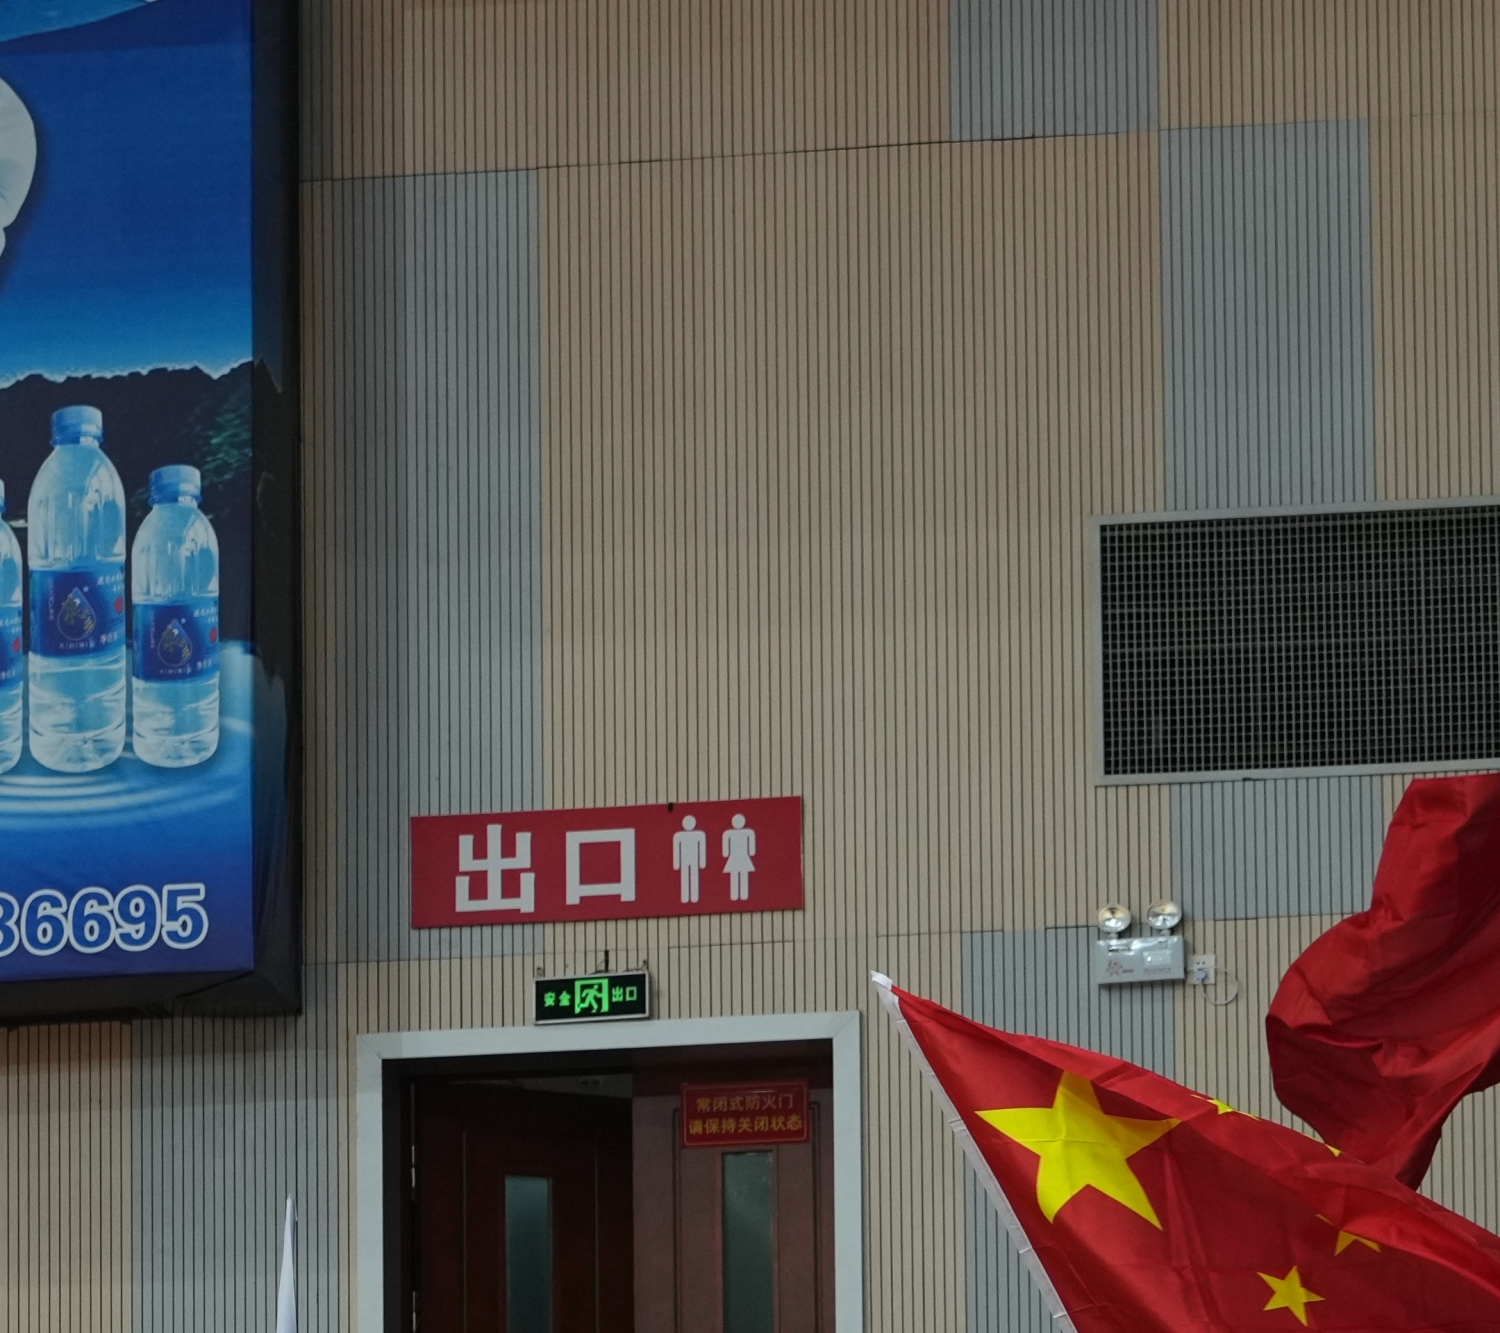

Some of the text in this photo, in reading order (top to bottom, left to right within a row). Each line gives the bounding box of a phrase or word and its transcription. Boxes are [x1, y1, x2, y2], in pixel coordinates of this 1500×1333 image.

[455, 824, 635, 913] 出口
[543, 986, 638, 1008] 安全 出口
[697, 1093, 793, 1113] 常闭式防火门
[689, 1115, 802, 1135] 请保持关闭状态
